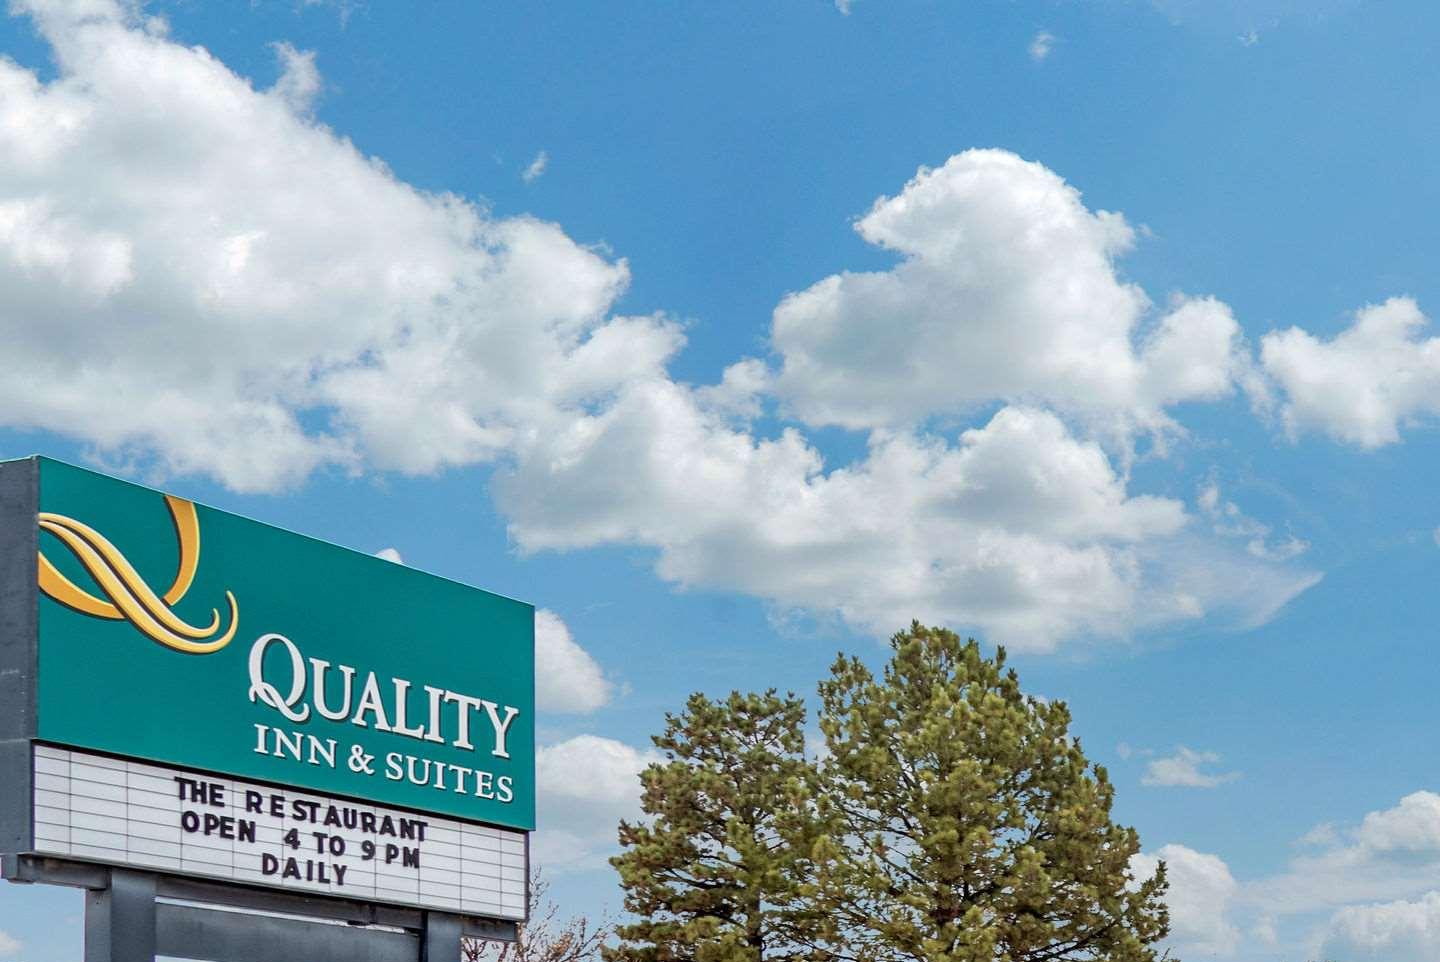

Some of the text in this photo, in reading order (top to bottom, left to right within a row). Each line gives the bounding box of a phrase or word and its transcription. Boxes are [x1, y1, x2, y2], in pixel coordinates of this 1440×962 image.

[248, 633, 519, 759] QUALITY
[254, 723, 514, 802] INN & SUITES
[174, 776, 428, 842] THE RESTAURANT
[181, 810, 256, 843] OPEN
[283, 828, 300, 850] 4
[313, 832, 346, 857] TO
[361, 840, 376, 861] 9
[262, 853, 347, 886] DAILY
